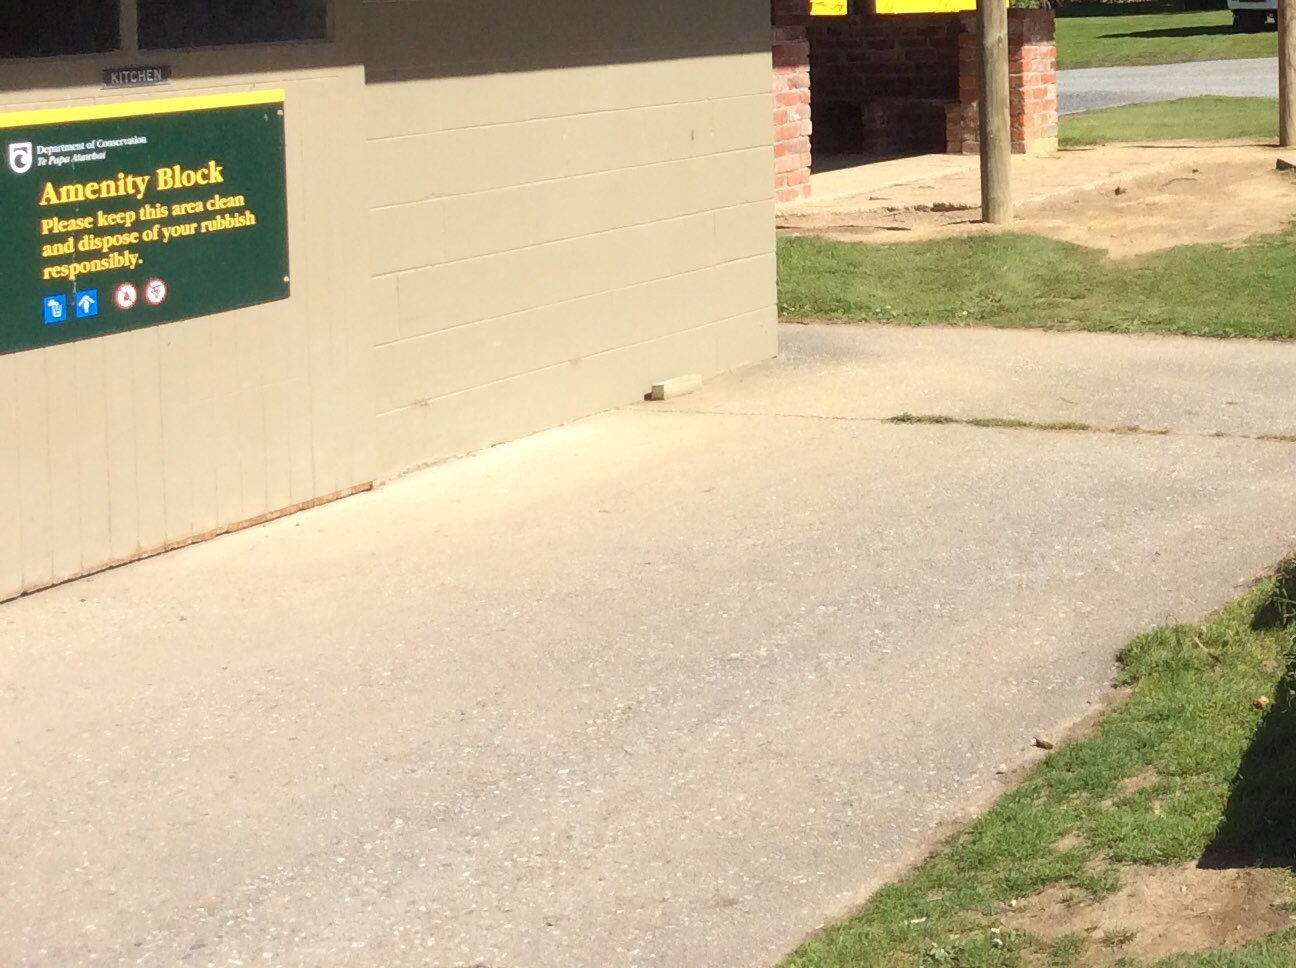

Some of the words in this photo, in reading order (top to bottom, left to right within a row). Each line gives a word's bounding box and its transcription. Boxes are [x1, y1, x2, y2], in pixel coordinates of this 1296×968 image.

[110, 69, 162, 83] KITCHEN
[36, 142, 85, 155] Department
[86, 139, 95, 149] of
[96, 135, 147, 148] Conservation
[37, 156, 47, 166] Te
[48, 155, 71, 166] Papa
[38, 172, 150, 206] Amenity
[156, 160, 224, 191] Block
[41, 216, 93, 235] Please
[97, 210, 136, 228] keep
[139, 204, 169, 220] this
[172, 200, 203, 216] area
[206, 194, 245, 211] clean
[42, 237, 75, 257] and
[78, 231, 139, 252] dispose
[142, 225, 160, 242] of
[161, 222, 197, 243] your
[201, 210, 256, 232] rubbish
[42, 250, 143, 280] responsibly.
